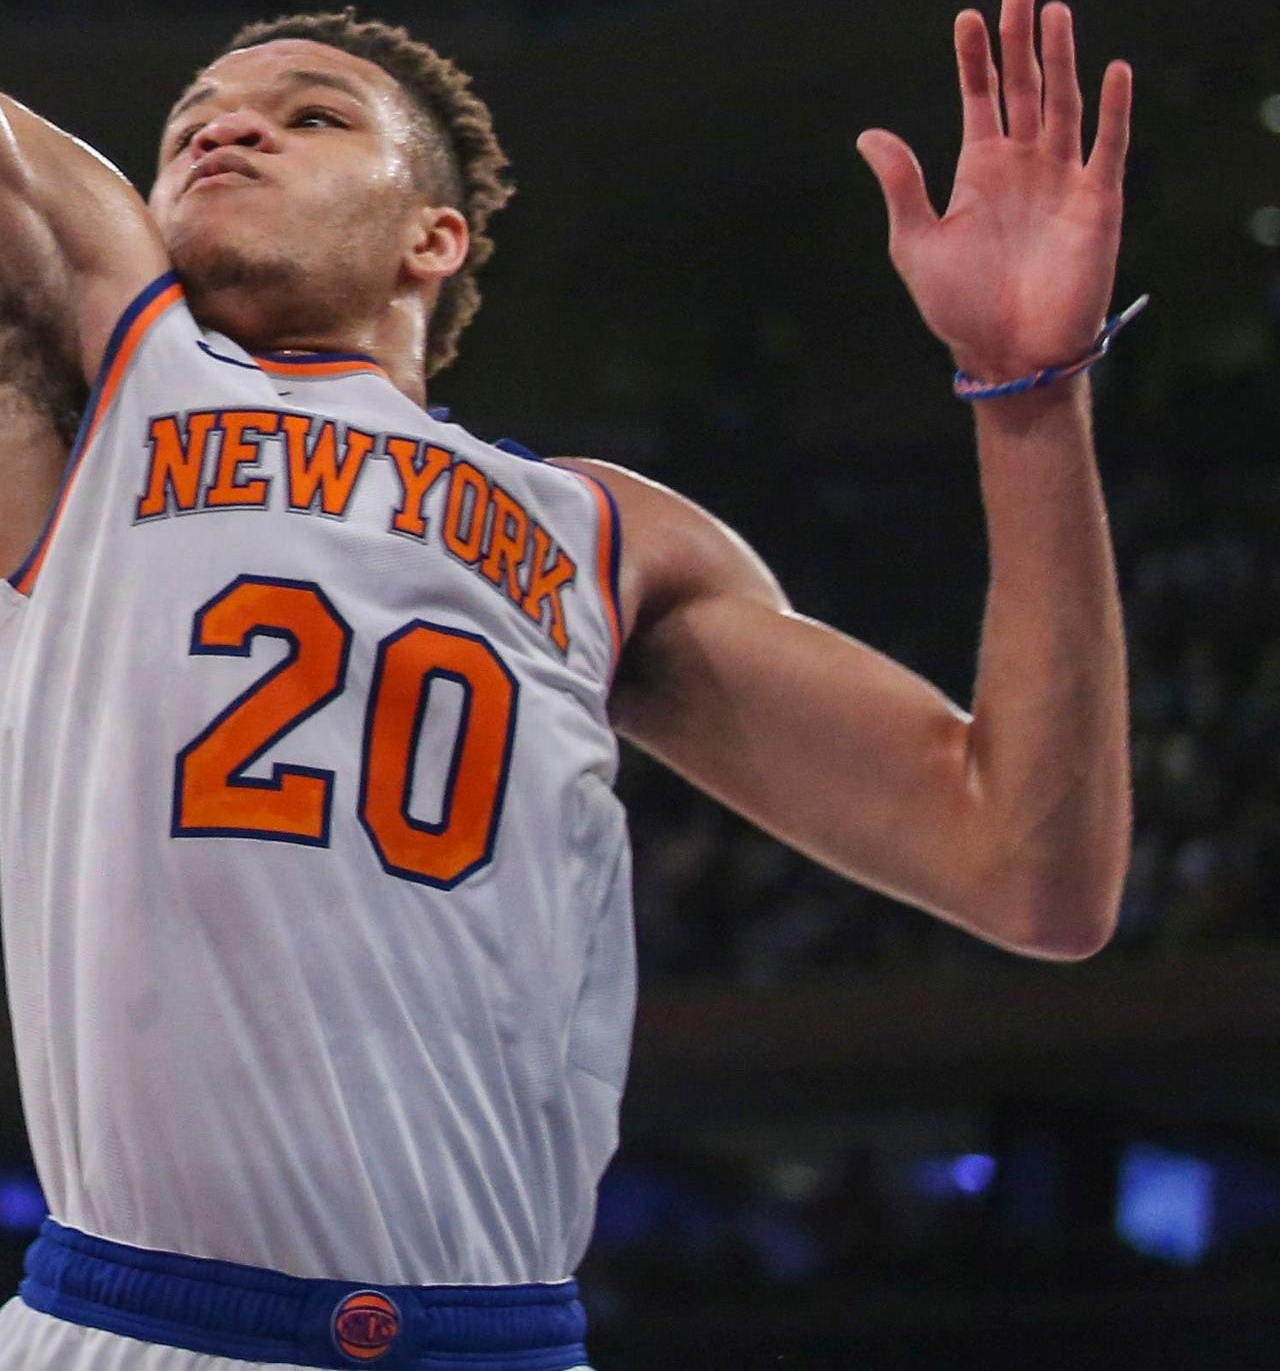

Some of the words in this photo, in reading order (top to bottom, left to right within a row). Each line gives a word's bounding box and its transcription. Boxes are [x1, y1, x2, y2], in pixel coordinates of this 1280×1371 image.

[133, 409, 375, 526] NEW
[385, 434, 577, 656] YORK
[171, 573, 520, 891] 20
